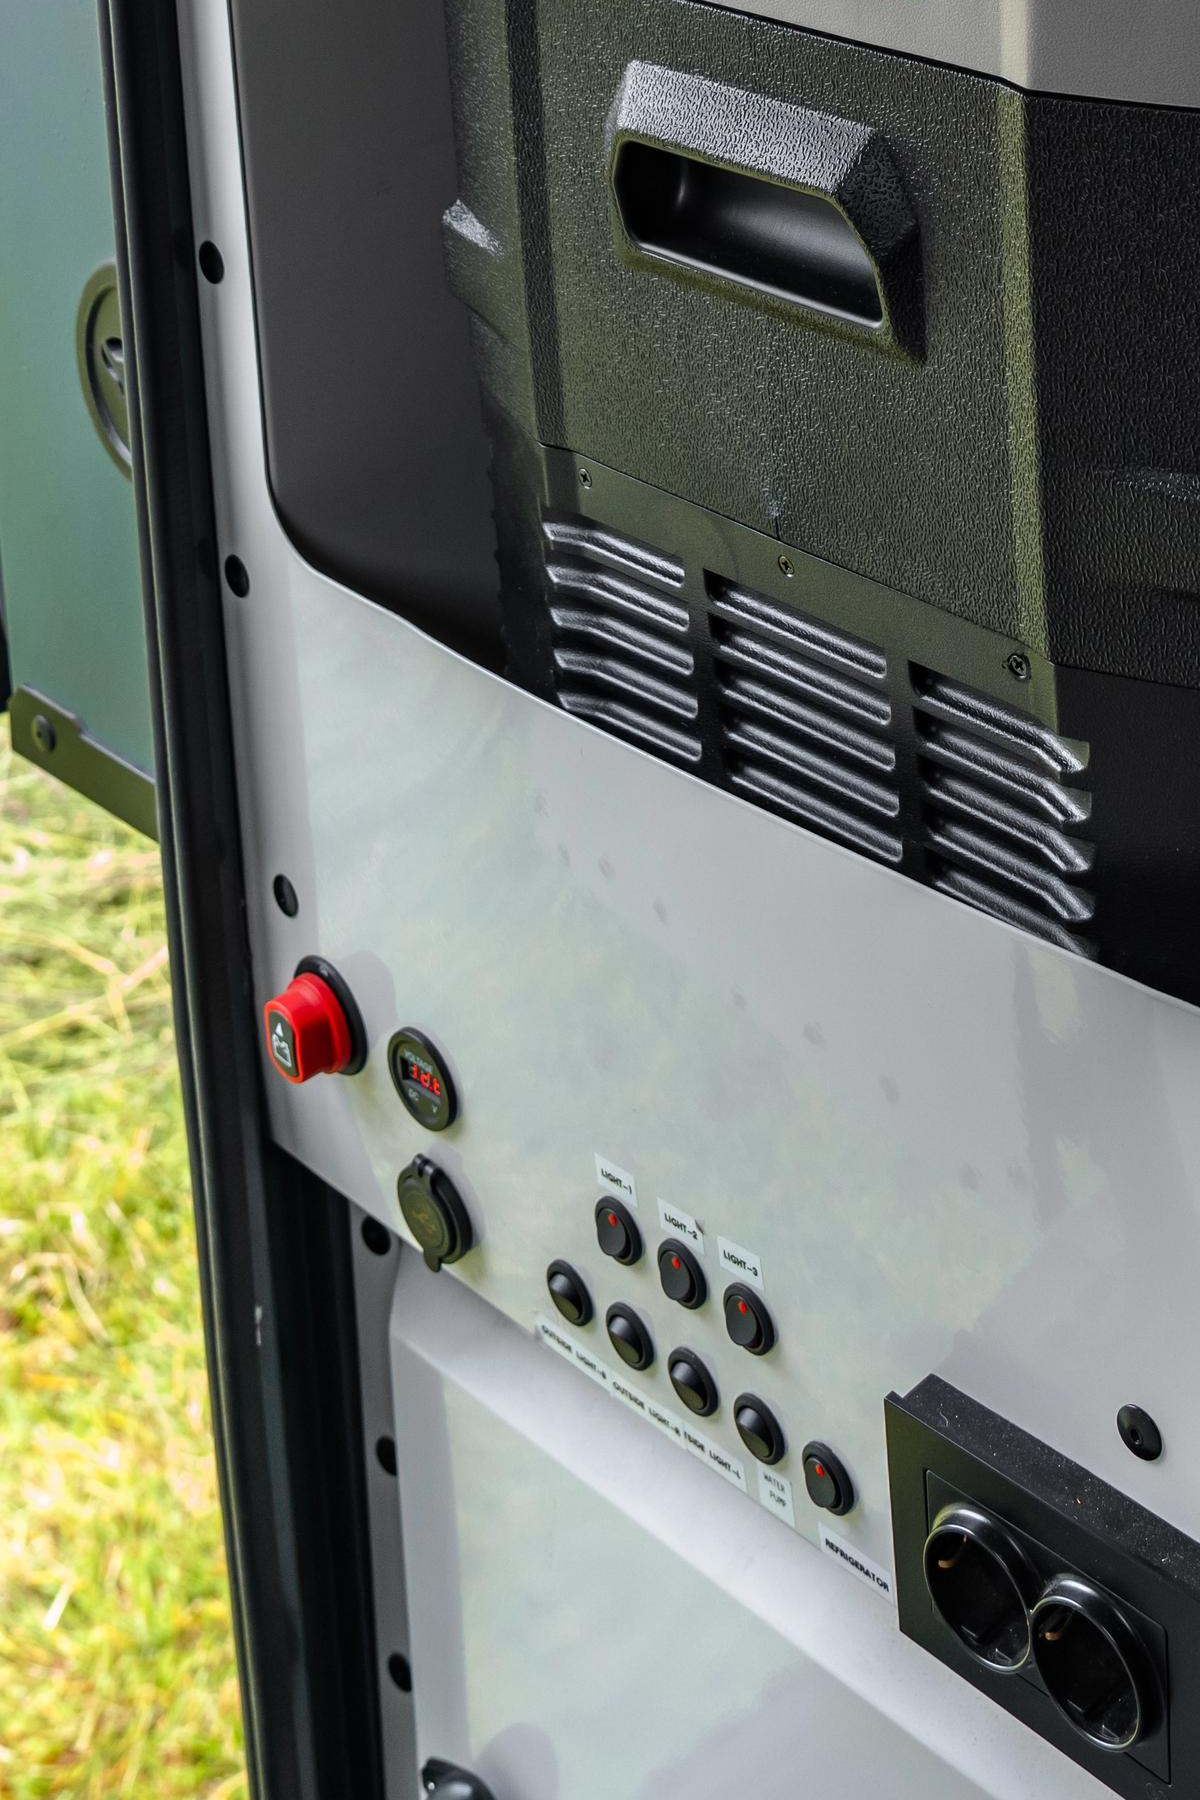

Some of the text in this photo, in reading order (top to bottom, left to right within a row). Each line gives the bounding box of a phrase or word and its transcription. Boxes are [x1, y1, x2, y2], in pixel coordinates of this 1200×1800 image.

[600, 1167, 633, 1195] LIGHT-1
[664, 1211, 698, 1241] LIGHT-2
[723, 1249, 759, 1277] LIGHT-3
[541, 1324, 573, 1354] OUTSIDE
[612, 1380, 646, 1410] OUTSIDE
[824, 1537, 890, 1593] REFRIGERATOR
